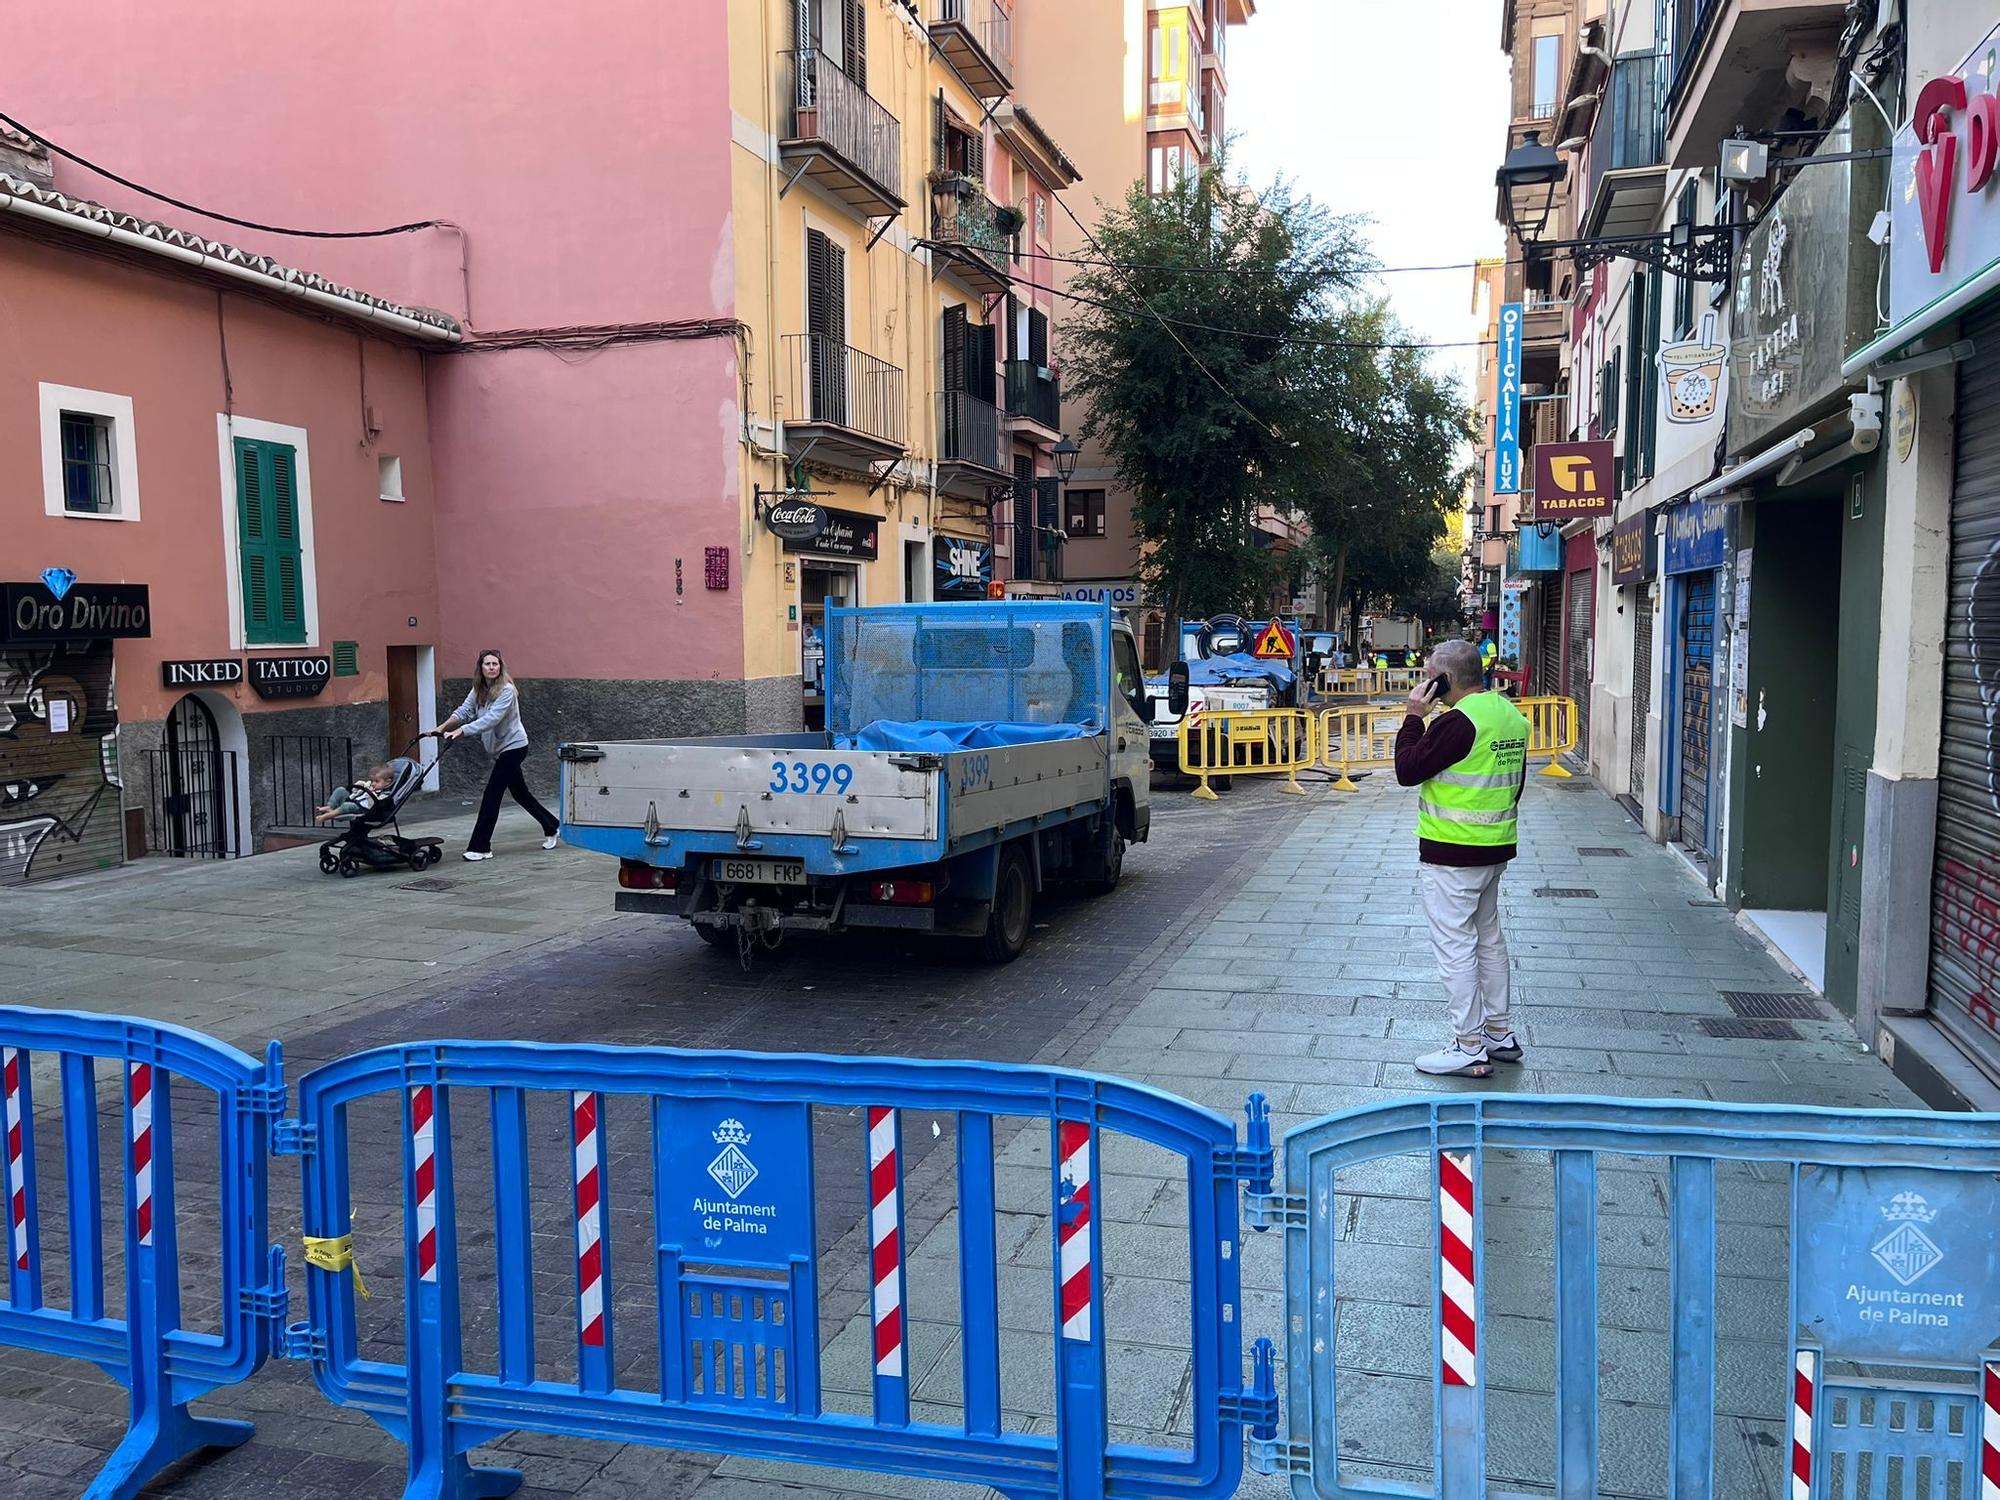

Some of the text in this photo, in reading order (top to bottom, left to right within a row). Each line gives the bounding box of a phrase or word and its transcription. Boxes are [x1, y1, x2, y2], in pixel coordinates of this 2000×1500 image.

[1500, 450, 1512, 490] LUX
[1541, 496, 1606, 510] TABACOS
[16, 596, 146, 630] Oro Divino
[171, 662, 241, 684] INKED
[256, 659, 328, 679] TATTOO
[267, 684, 319, 695] STUDIO
[769, 761, 854, 795] 3399
[960, 753, 990, 790] 3399
[726, 863, 802, 882] 6681 FKP
[693, 1198, 776, 1217] Ajuntament
[703, 1216, 767, 1234] de Palma
[1846, 1284, 1964, 1307] Ajuntament
[1859, 1306, 1949, 1327] de Palma
